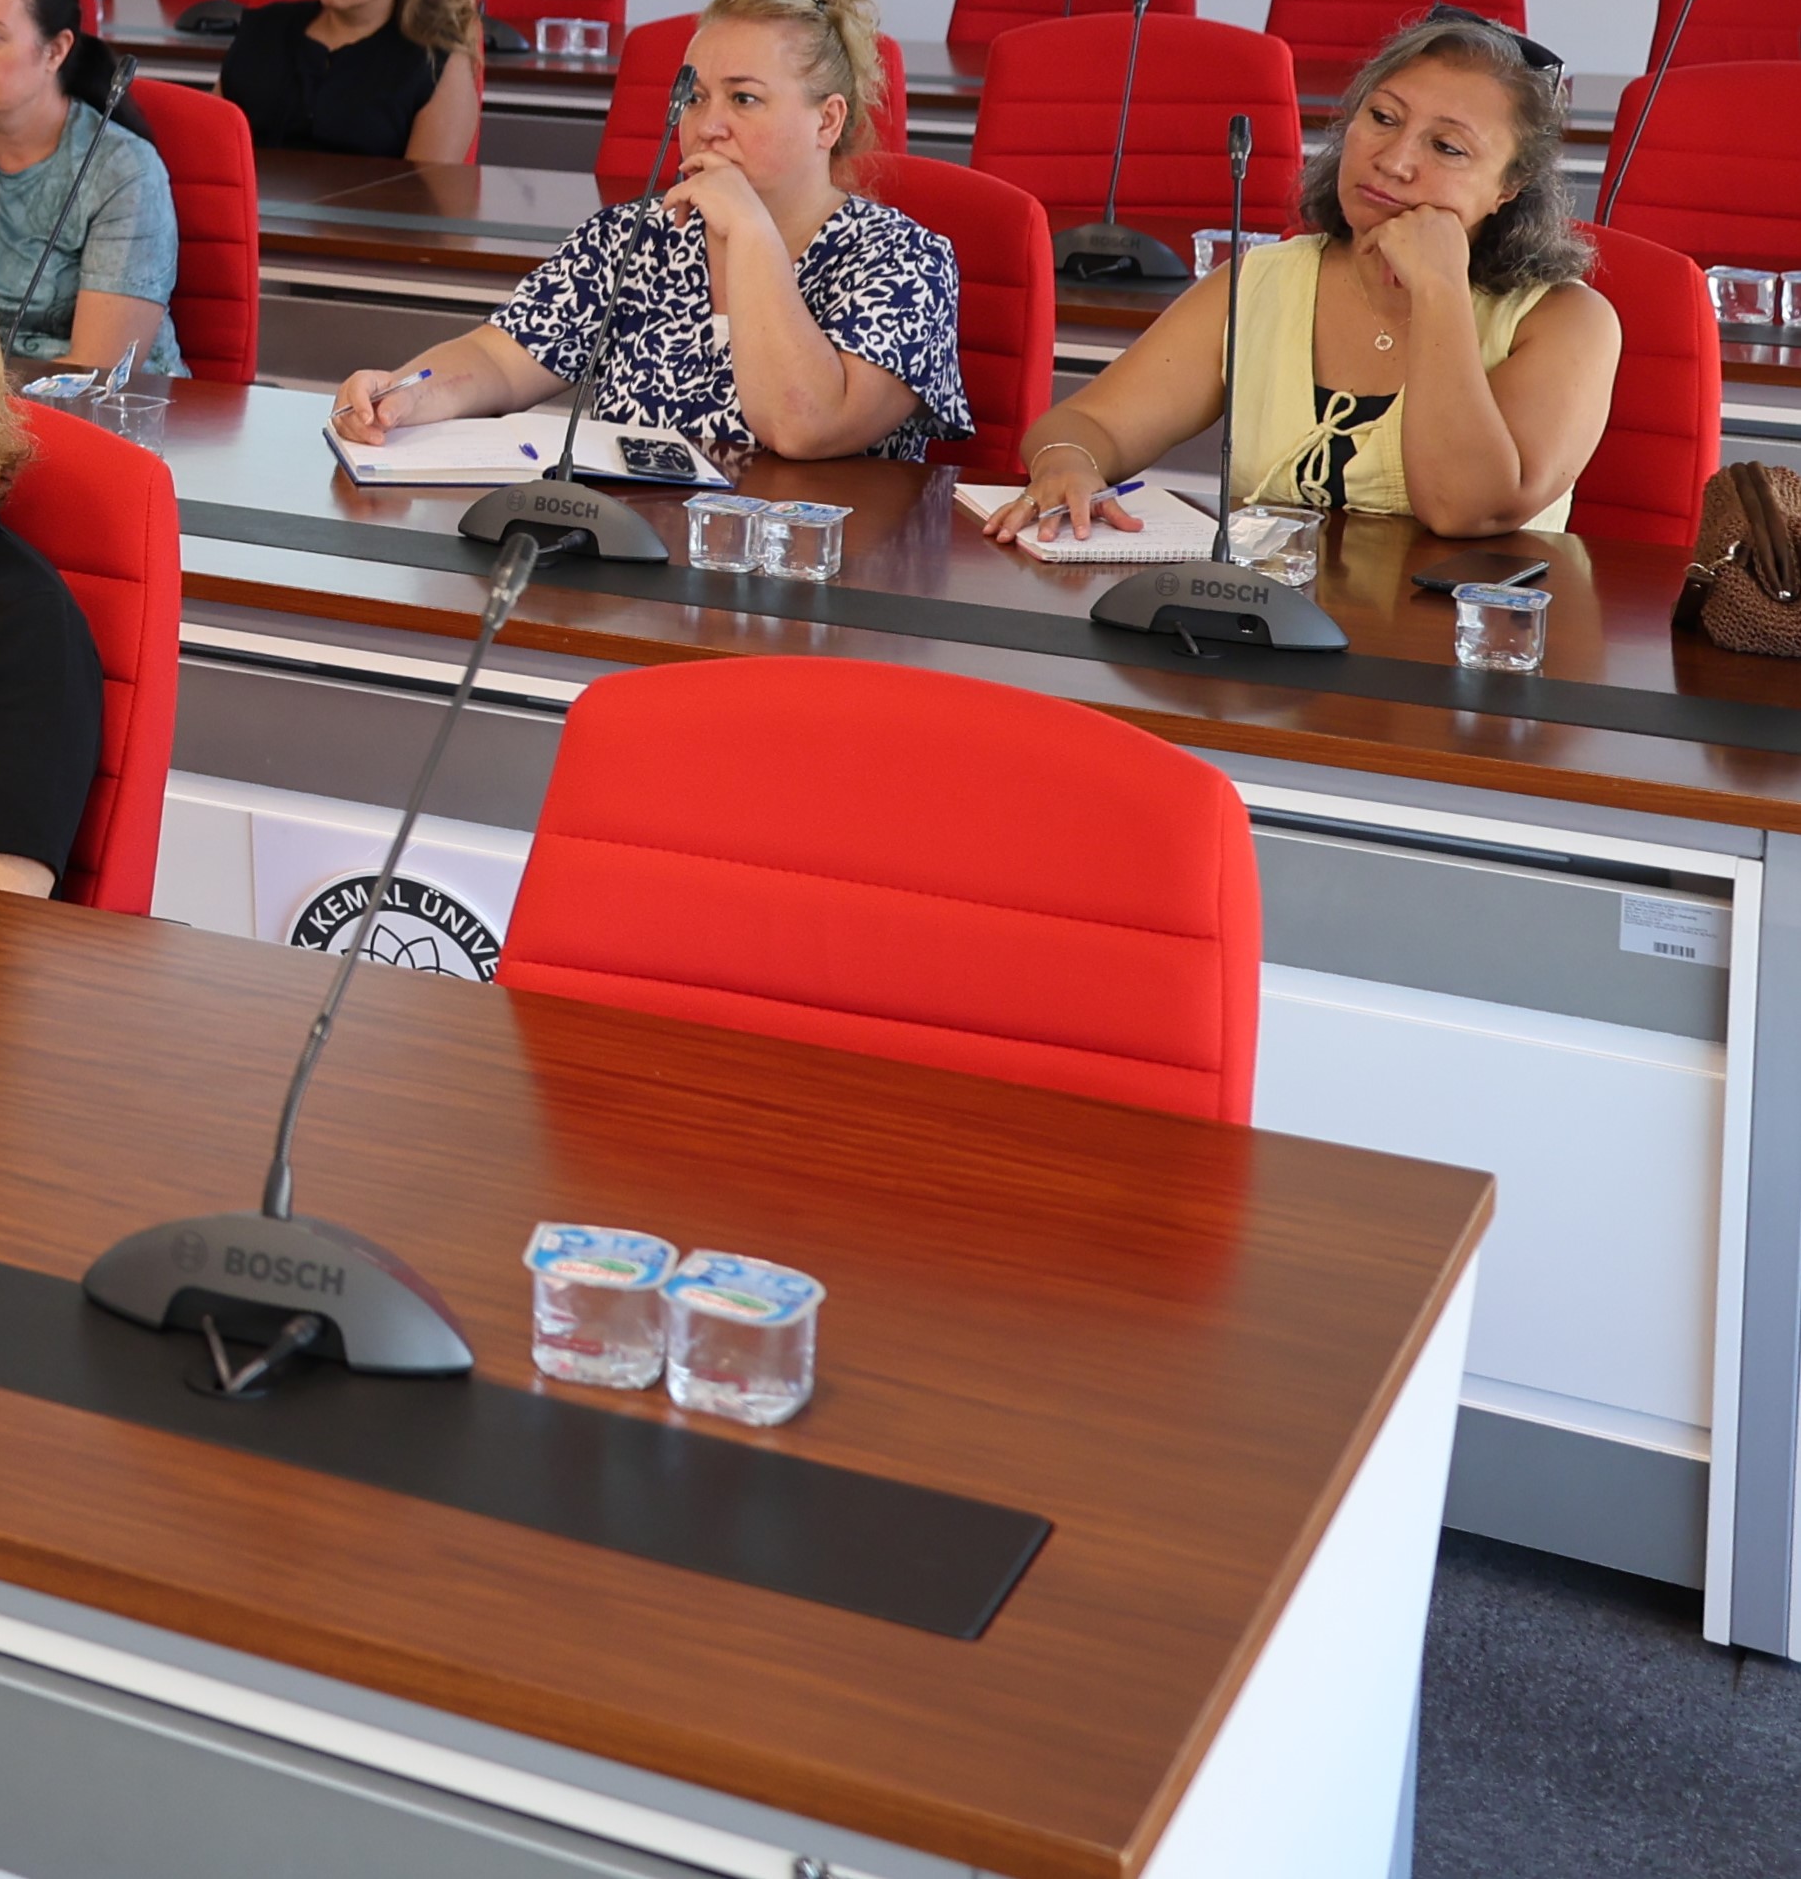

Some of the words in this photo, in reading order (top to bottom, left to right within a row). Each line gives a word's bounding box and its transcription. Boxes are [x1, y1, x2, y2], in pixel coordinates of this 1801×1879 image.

[1090, 234, 1141, 250] BOSCH
[534, 495, 600, 520] BOSCH
[1190, 578, 1270, 606] BOSCH
[223, 1242, 346, 1295] BOSCH
